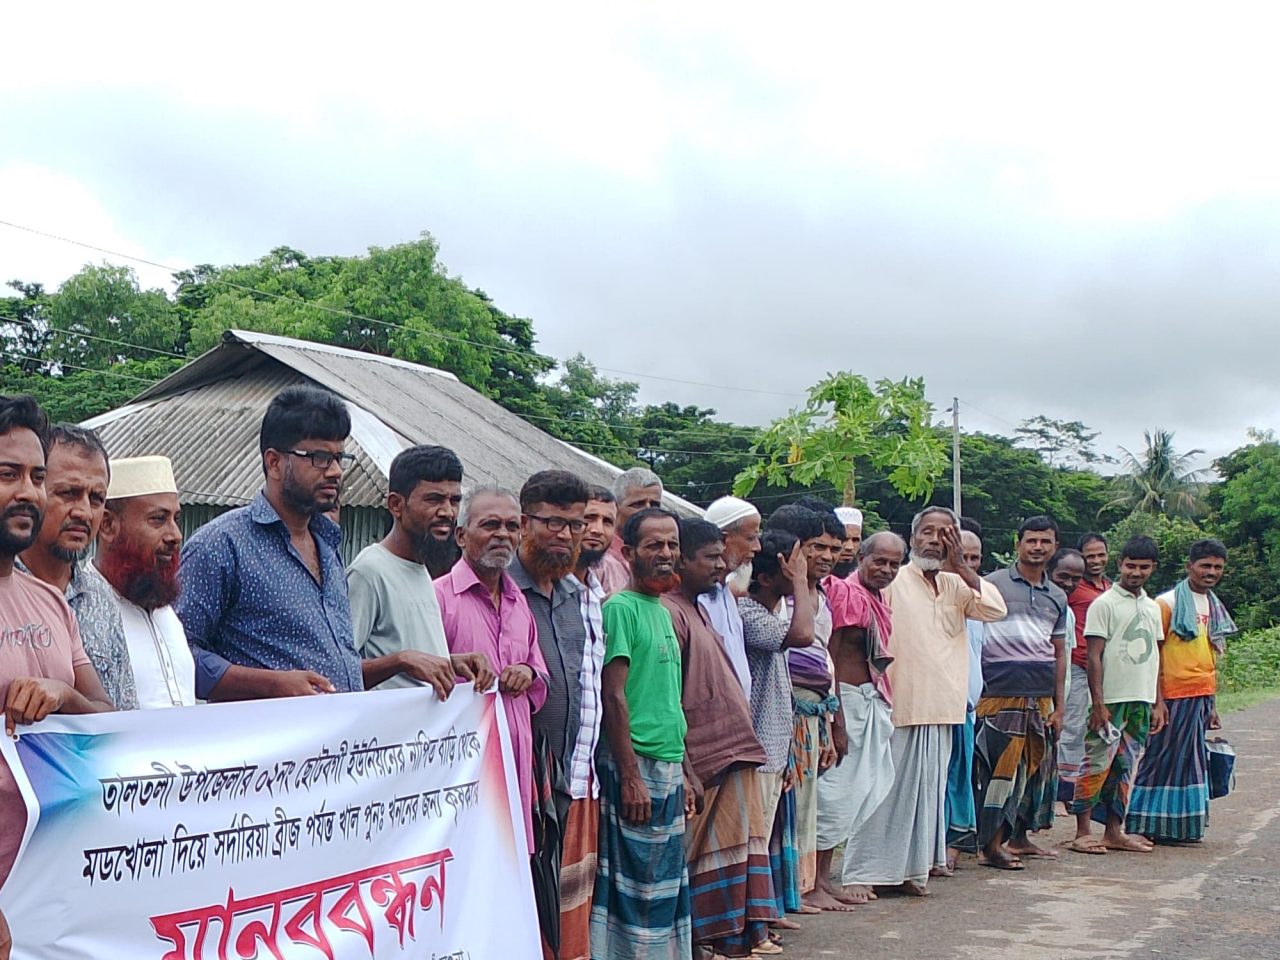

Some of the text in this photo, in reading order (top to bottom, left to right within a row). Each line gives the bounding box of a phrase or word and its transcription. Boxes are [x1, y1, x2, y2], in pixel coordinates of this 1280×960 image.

[98, 761, 177, 817] তালতলী
[175, 760, 259, 805] উপজেলার
[255, 761, 296, 799] ০২নং
[346, 737, 405, 785] ইউনিয়নের
[458, 731, 481, 762] থেকে
[171, 823, 210, 875] দিয়ে
[213, 813, 271, 867] সর্দারিয়া
[272, 806, 302, 860] ব্রীজ
[305, 799, 337, 848] পর্যন্ত
[339, 803, 362, 840] খাল
[364, 800, 385, 843] পুনঃ
[388, 793, 421, 829] খননের
[421, 789, 443, 820] জন্য
